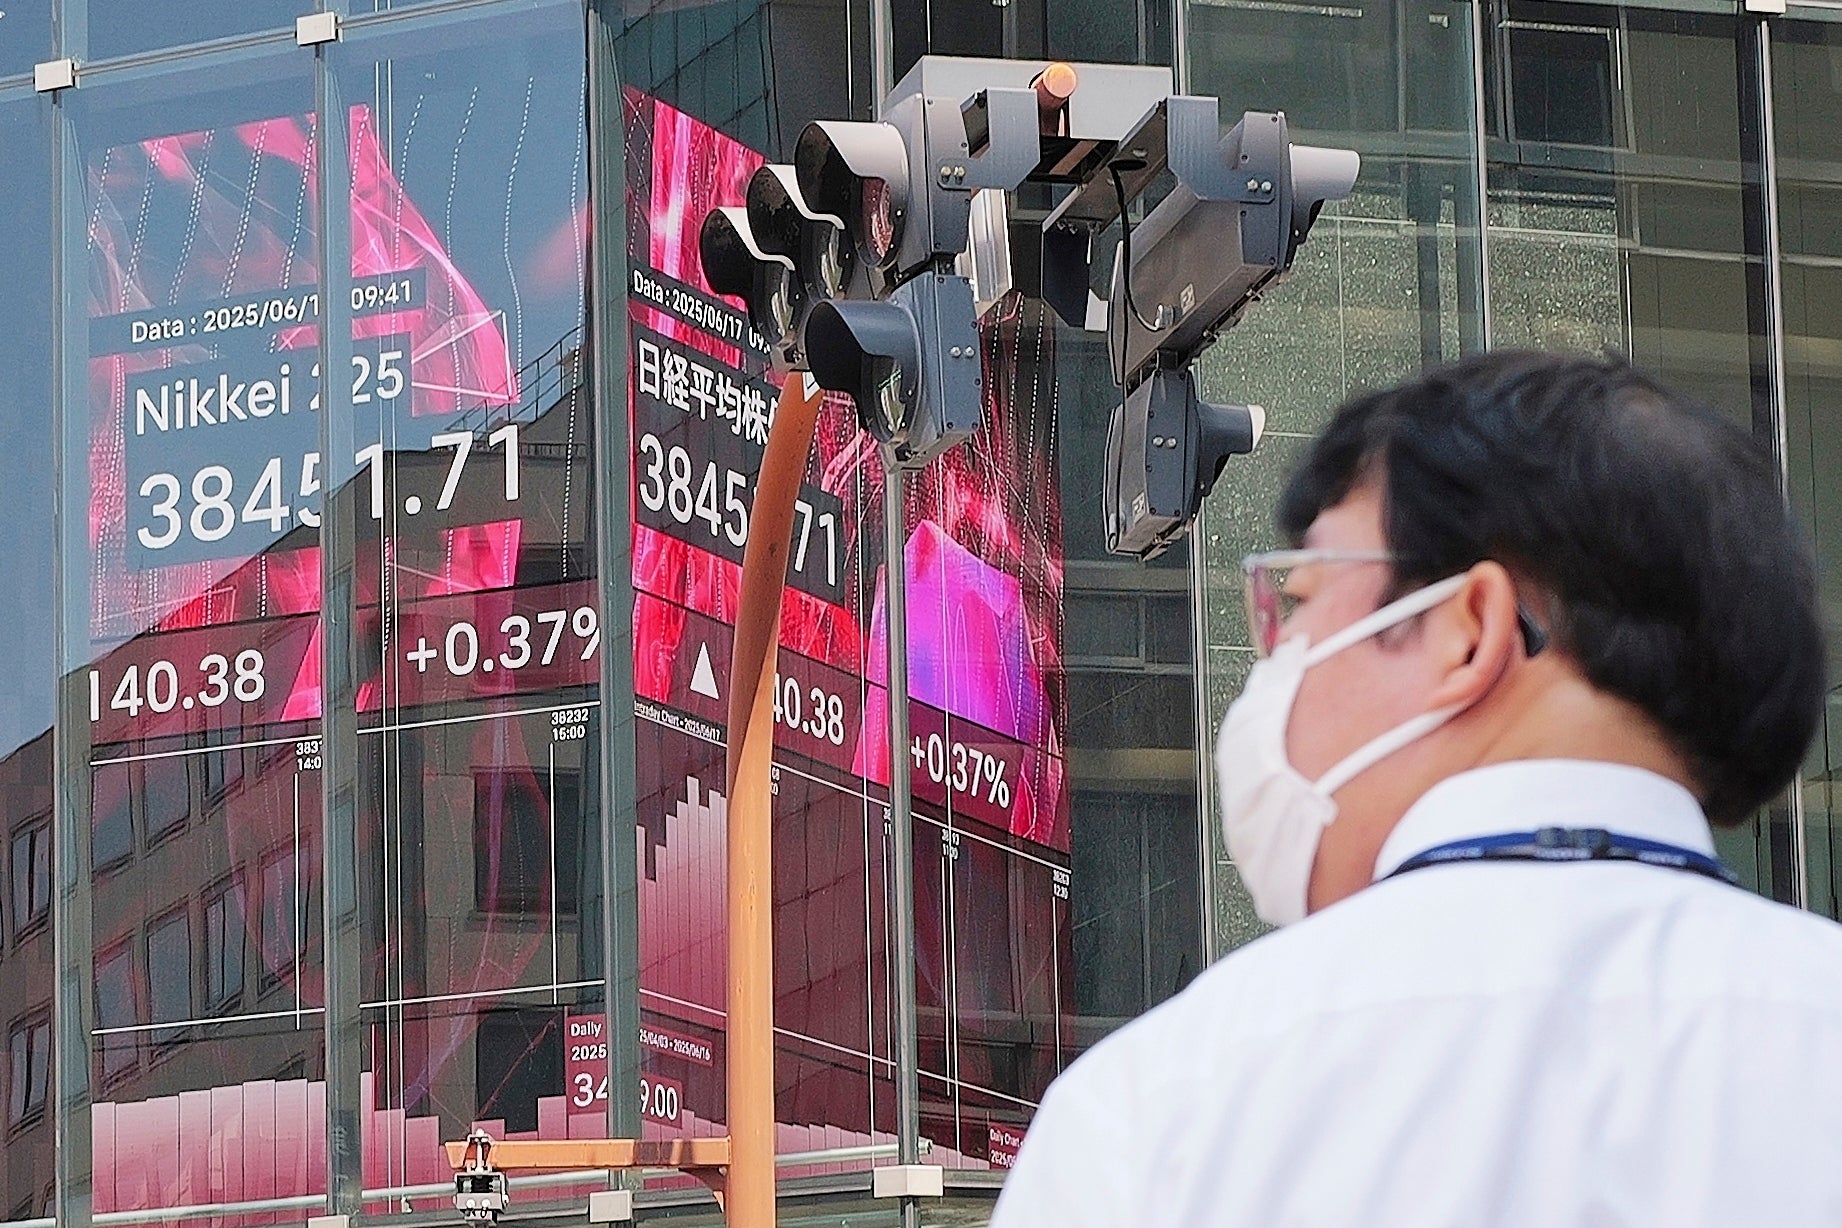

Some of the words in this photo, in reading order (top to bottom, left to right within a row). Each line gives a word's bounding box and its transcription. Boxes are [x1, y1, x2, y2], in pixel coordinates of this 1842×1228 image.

[131, 318, 184, 344] Data
[203, 293, 319, 333] 2025/06/1
[351, 280, 411, 310] 09:41
[633, 269, 664, 306] Data
[672, 289, 743, 341] 2025/06/17
[136, 363, 290, 436] Nikkei
[638, 338, 778, 445] 日経平均株
[137, 424, 519, 549] 38451.71
[551, 708, 589, 725] 38232
[773, 672, 845, 746] 40.38
[910, 733, 1010, 809] +0.37%
